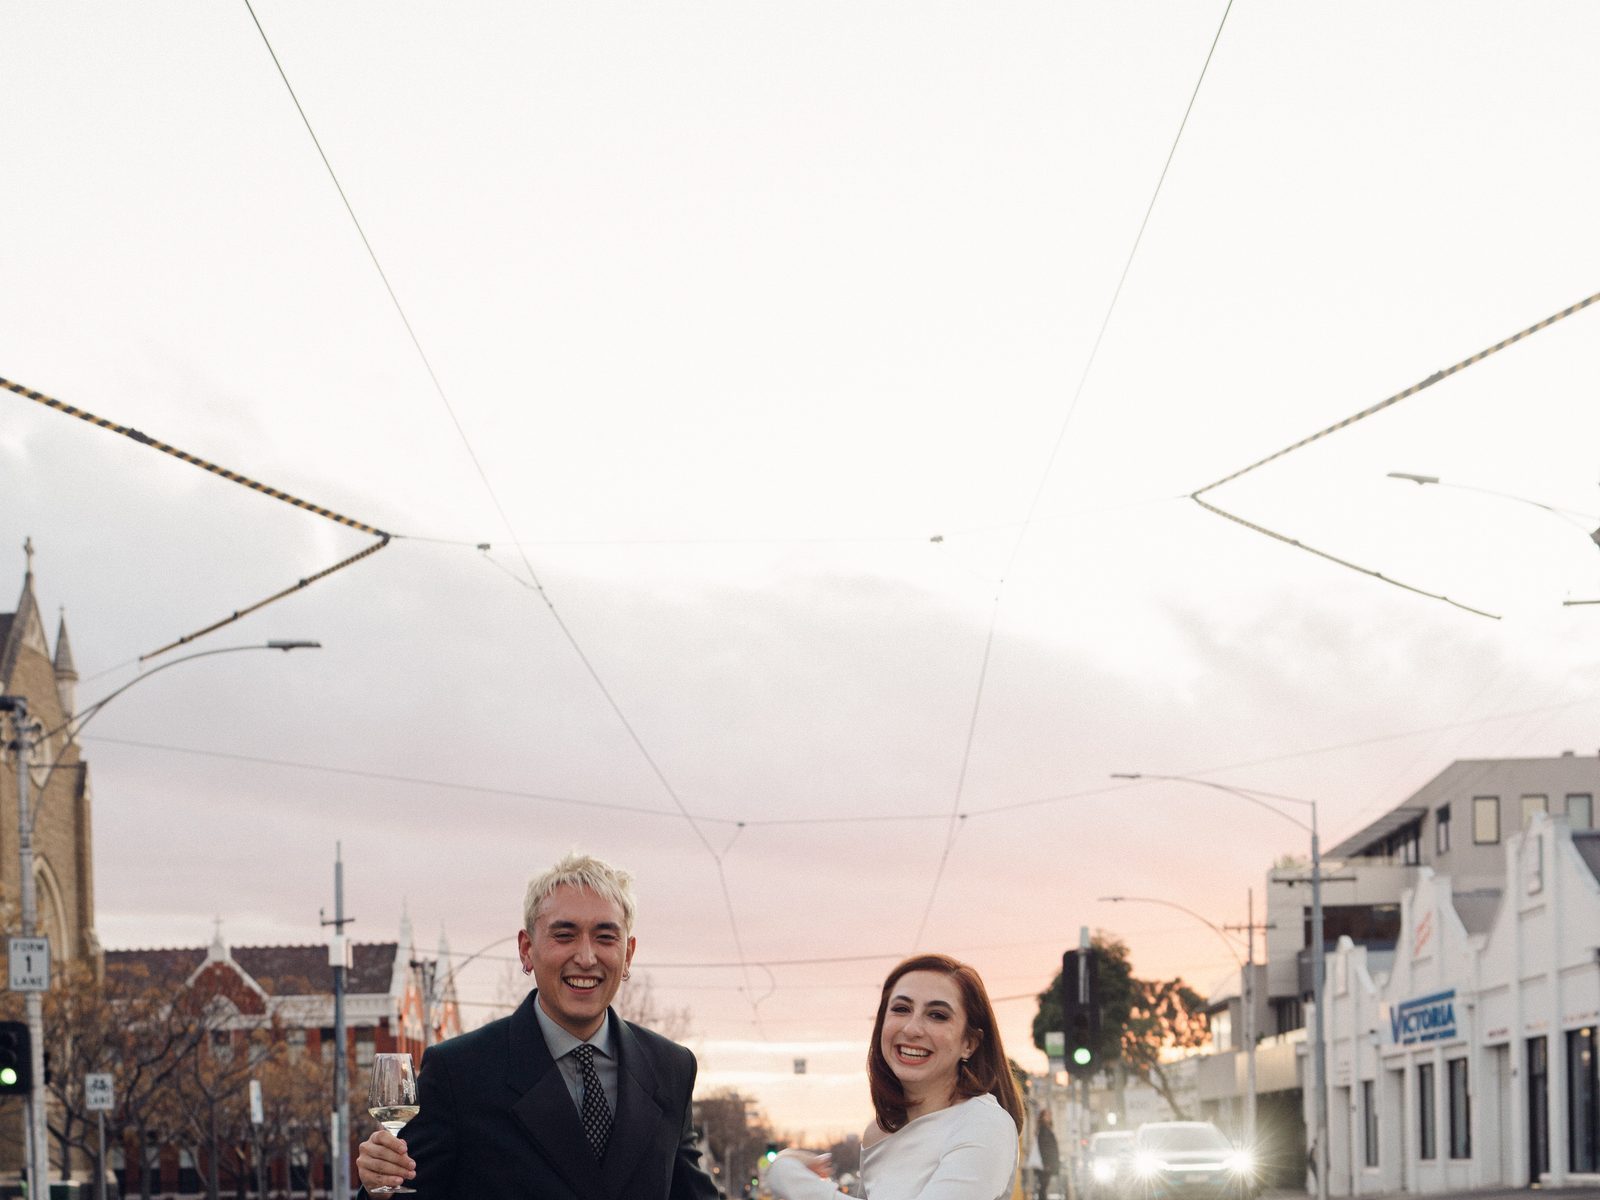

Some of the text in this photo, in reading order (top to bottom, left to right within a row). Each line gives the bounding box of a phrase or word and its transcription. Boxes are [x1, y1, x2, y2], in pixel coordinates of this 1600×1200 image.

[13, 943, 44, 952] FORM
[26, 955, 31, 973] 1
[13, 977, 42, 986] LANE
[1390, 1003, 1455, 1043] VICTORIA
